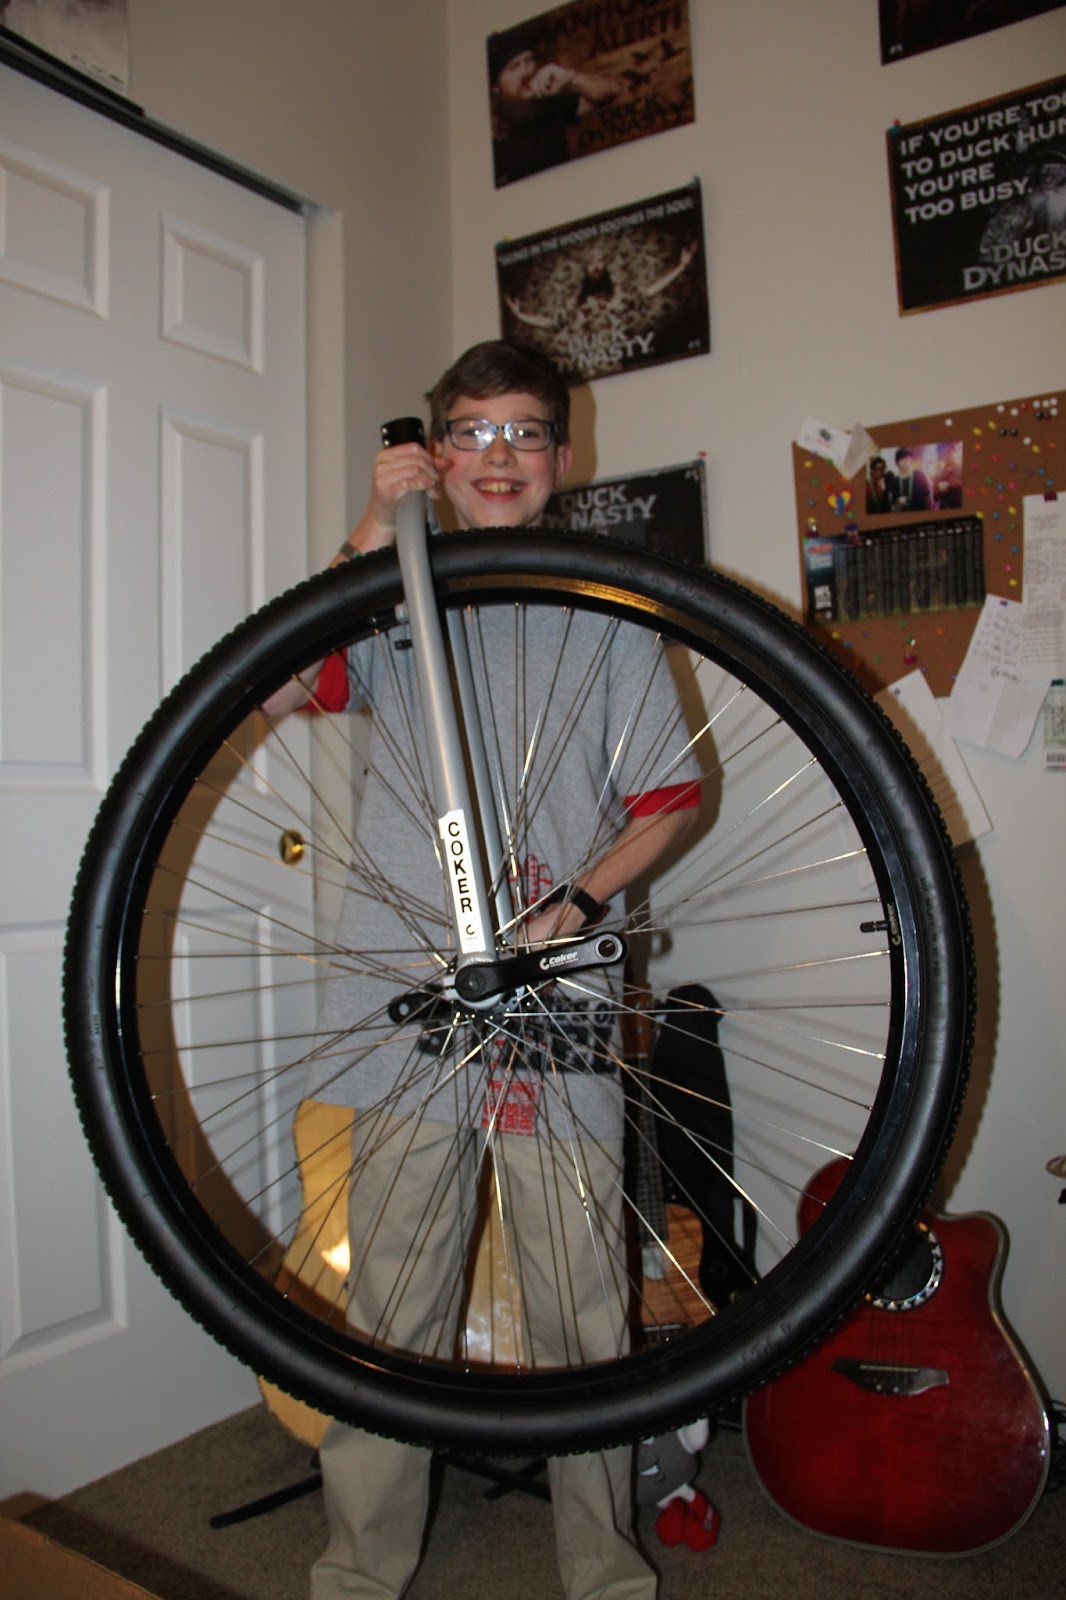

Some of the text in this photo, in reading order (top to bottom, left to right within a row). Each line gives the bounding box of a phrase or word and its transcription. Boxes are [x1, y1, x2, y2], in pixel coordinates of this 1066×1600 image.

[901, 134, 924, 156] IF
[928, 105, 1021, 147] YOU'RE
[902, 157, 934, 179] TO
[939, 132, 1011, 169] DUCK
[904, 162, 995, 200] YOU'RE
[905, 198, 954, 224] TOO
[448, 821, 473, 914] COKER
[549, 951, 578, 965] coker
